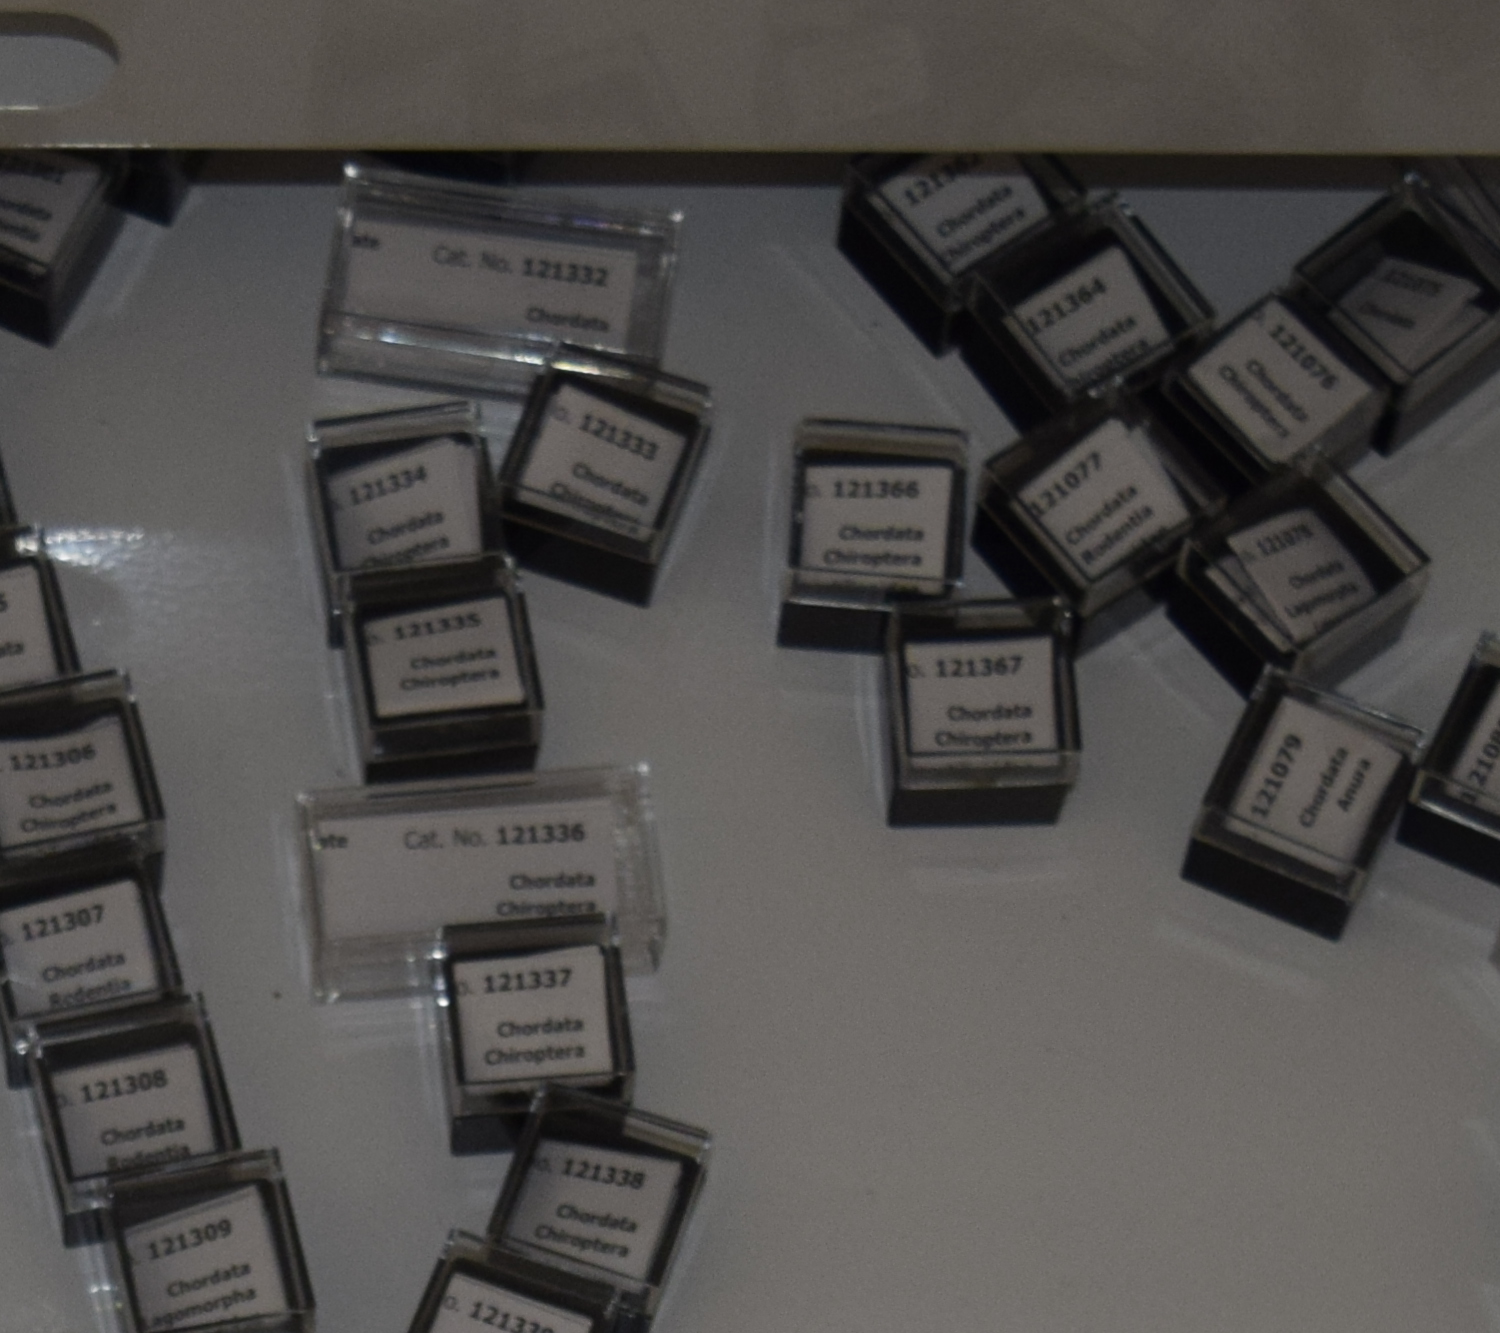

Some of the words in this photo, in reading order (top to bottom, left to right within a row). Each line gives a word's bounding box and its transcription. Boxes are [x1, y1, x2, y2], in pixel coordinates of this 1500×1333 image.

[524, 259, 607, 286] 121332
[937, 655, 1022, 677] 121367
[10, 744, 95, 771] 121306
[1252, 734, 1302, 817] 121079
[498, 823, 585, 845] 121336
[22, 904, 103, 941] 121307
[484, 968, 572, 993] 121337
[81, 1069, 167, 1103] 121308
